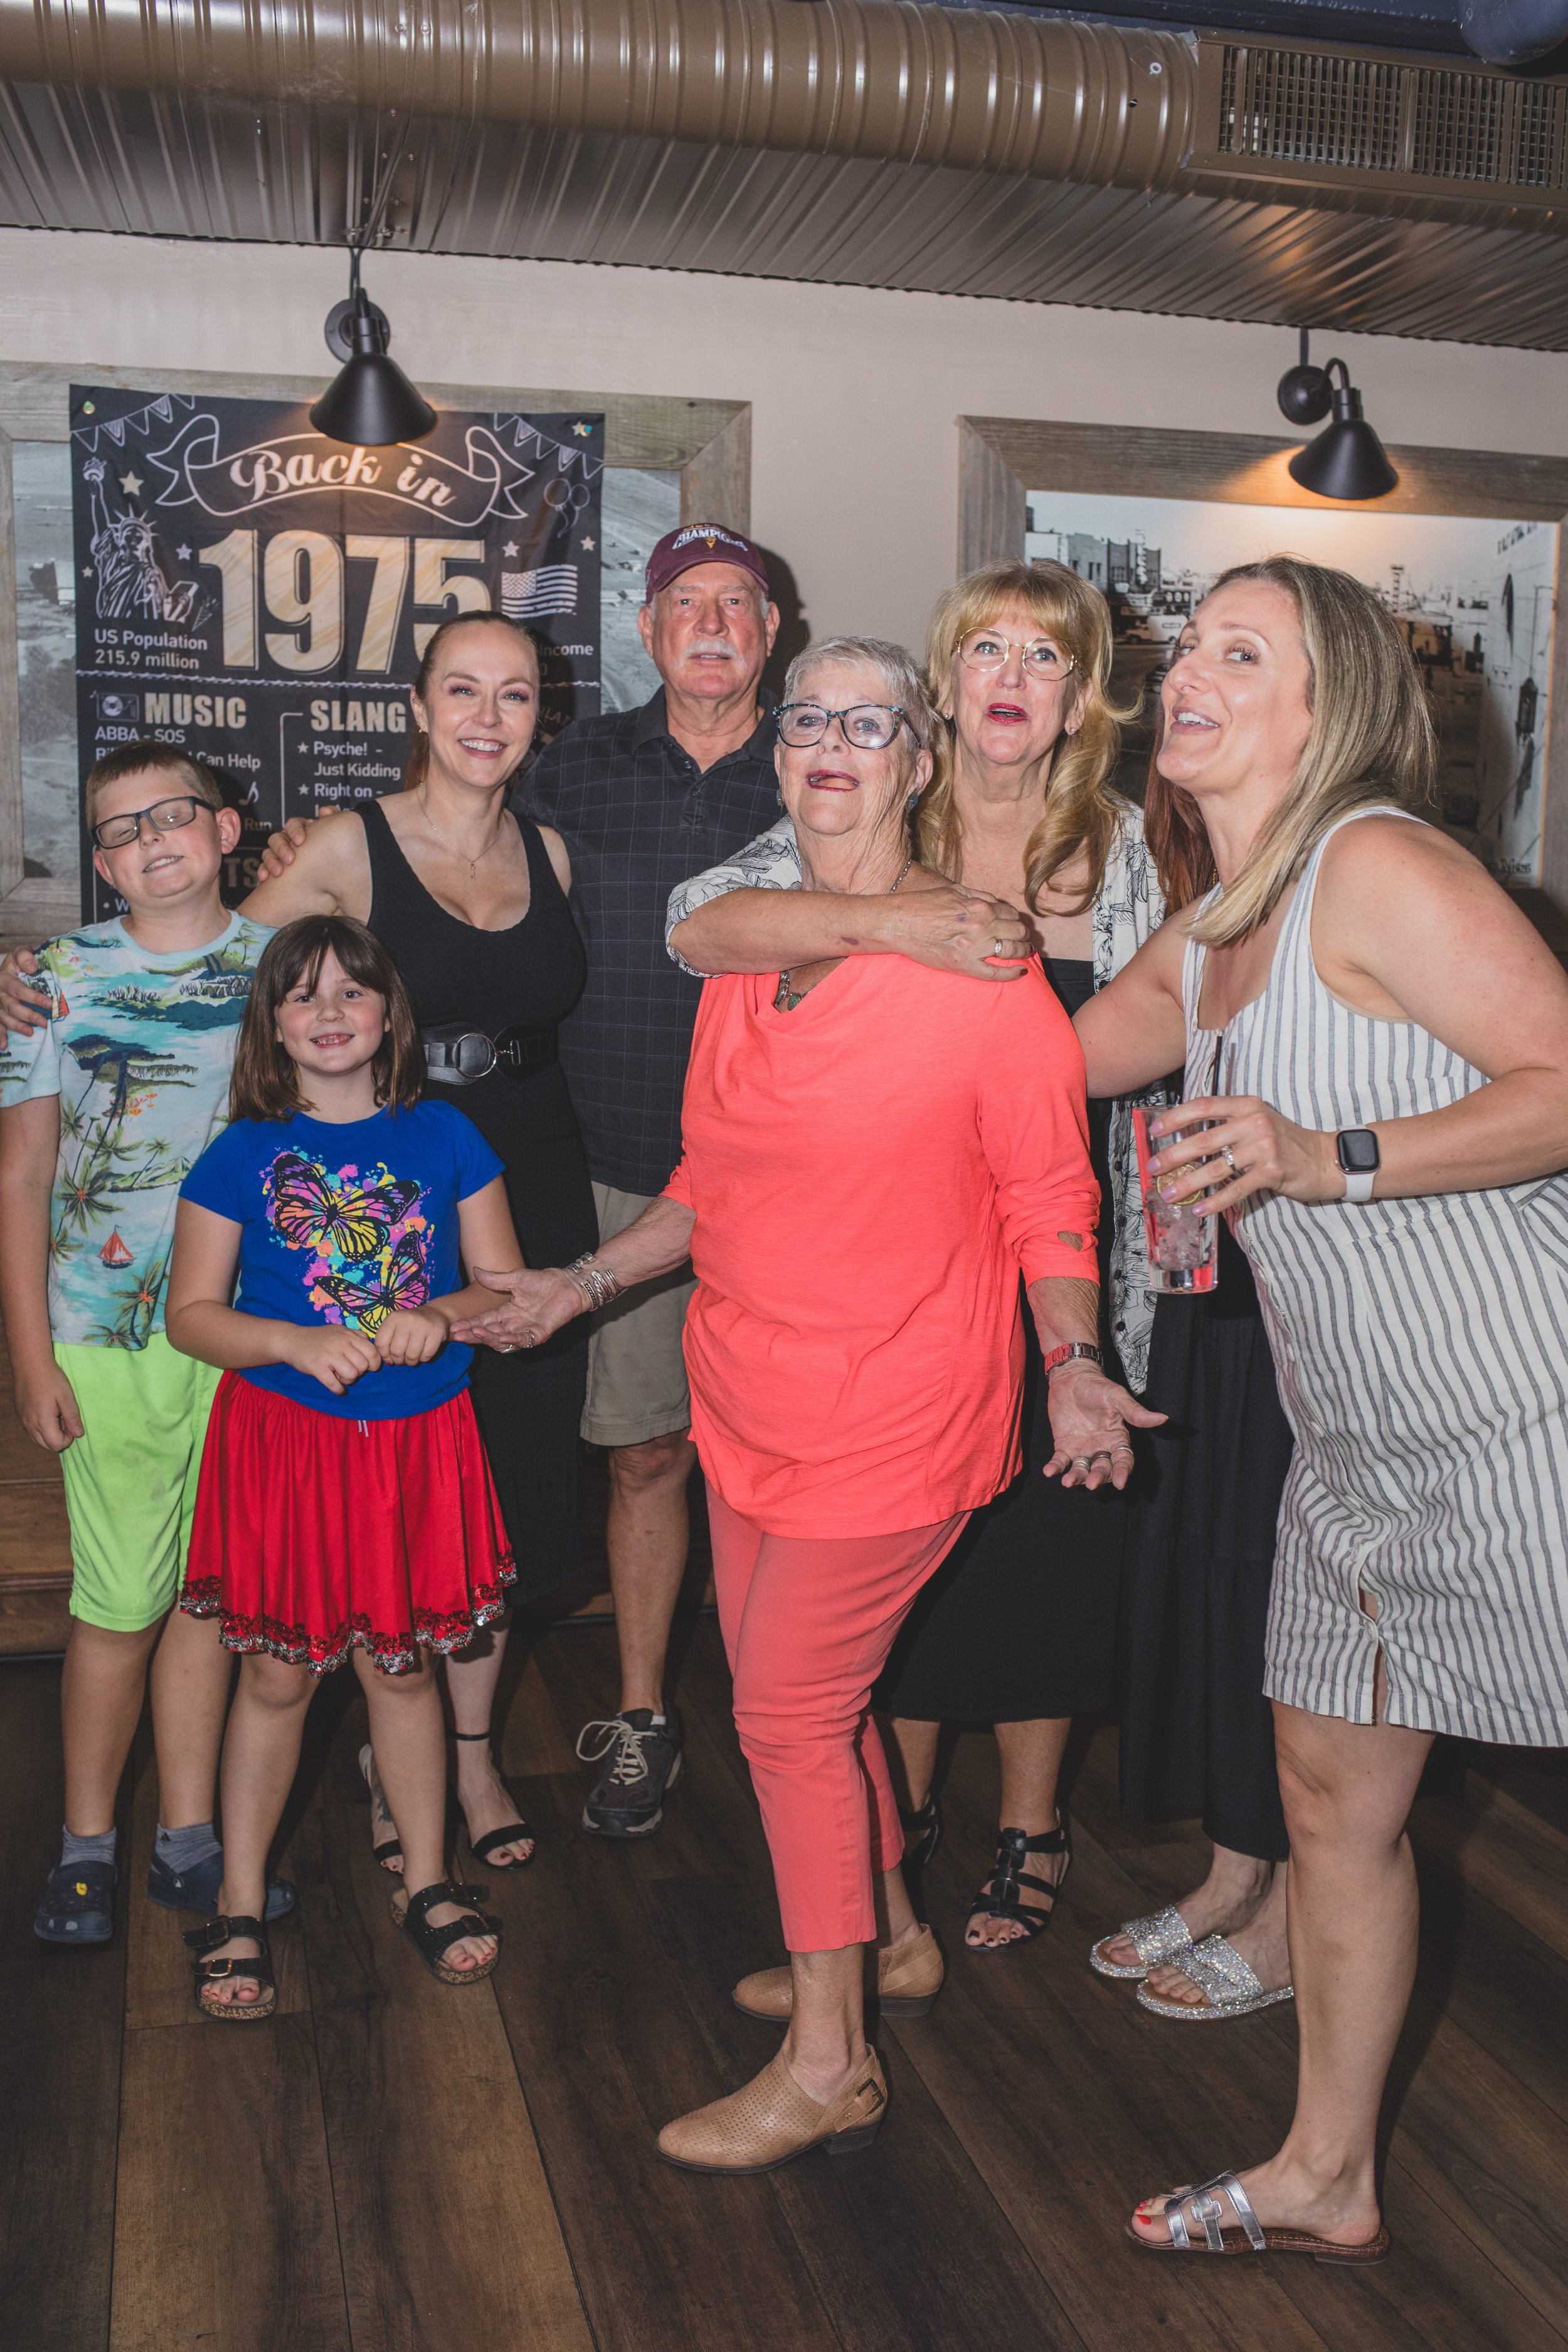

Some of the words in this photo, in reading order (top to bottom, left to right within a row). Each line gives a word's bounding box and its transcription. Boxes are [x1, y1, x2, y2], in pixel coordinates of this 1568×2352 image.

[230, 447, 381, 502] Back
[396, 453, 457, 507] in
[199, 529, 492, 675] 1975
[95, 628, 118, 644] US
[122, 630, 208, 651] Population
[95, 649, 140, 666] 215.9
[145, 652, 199, 670] million
[144, 692, 247, 729] MUSIC
[310, 699, 406, 734] SLANG
[95, 726, 139, 741] ABBA
[154, 728, 186, 744] SOS
[314, 741, 368, 759] Psyche!
[228, 753, 262, 772] Help
[314, 762, 345, 776] Just
[347, 763, 401, 781] Kidding
[314, 783, 351, 801] Right
[354, 788, 373, 798] on
[244, 817, 273, 832] Run
